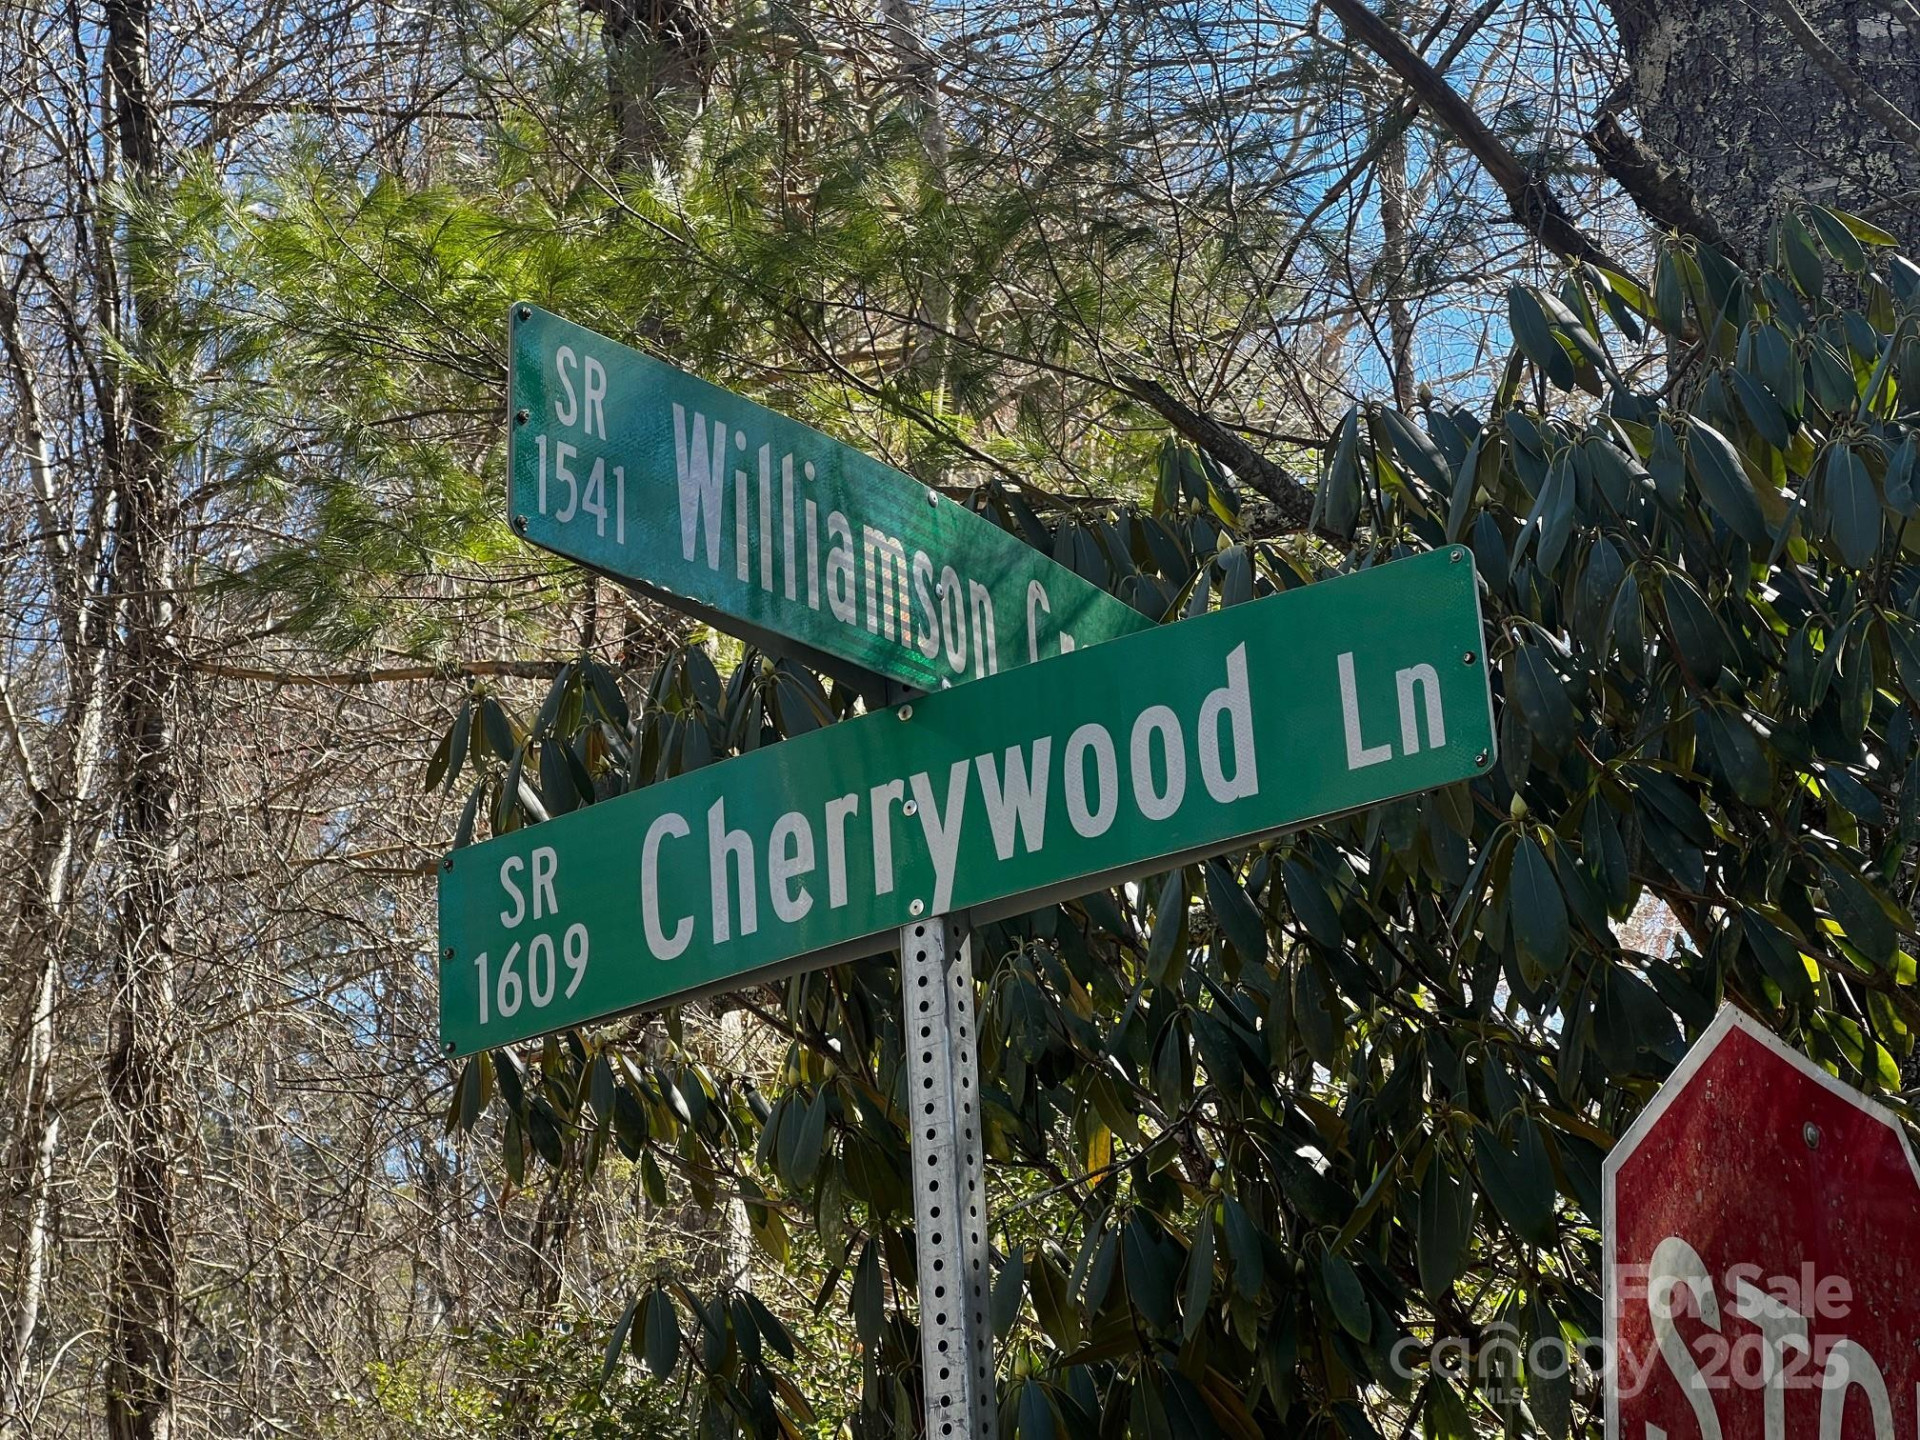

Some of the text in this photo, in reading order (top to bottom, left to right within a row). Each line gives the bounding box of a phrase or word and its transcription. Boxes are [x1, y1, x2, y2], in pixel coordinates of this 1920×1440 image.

[555, 346, 607, 440] SR
[535, 435, 625, 545] 1541
[672, 403, 998, 680] Williamson
[641, 641, 1447, 961] Cherrywood Ln
[499, 846, 558, 929] SR
[473, 922, 589, 1025] 1609
[1646, 1236, 1920, 1440] ST
